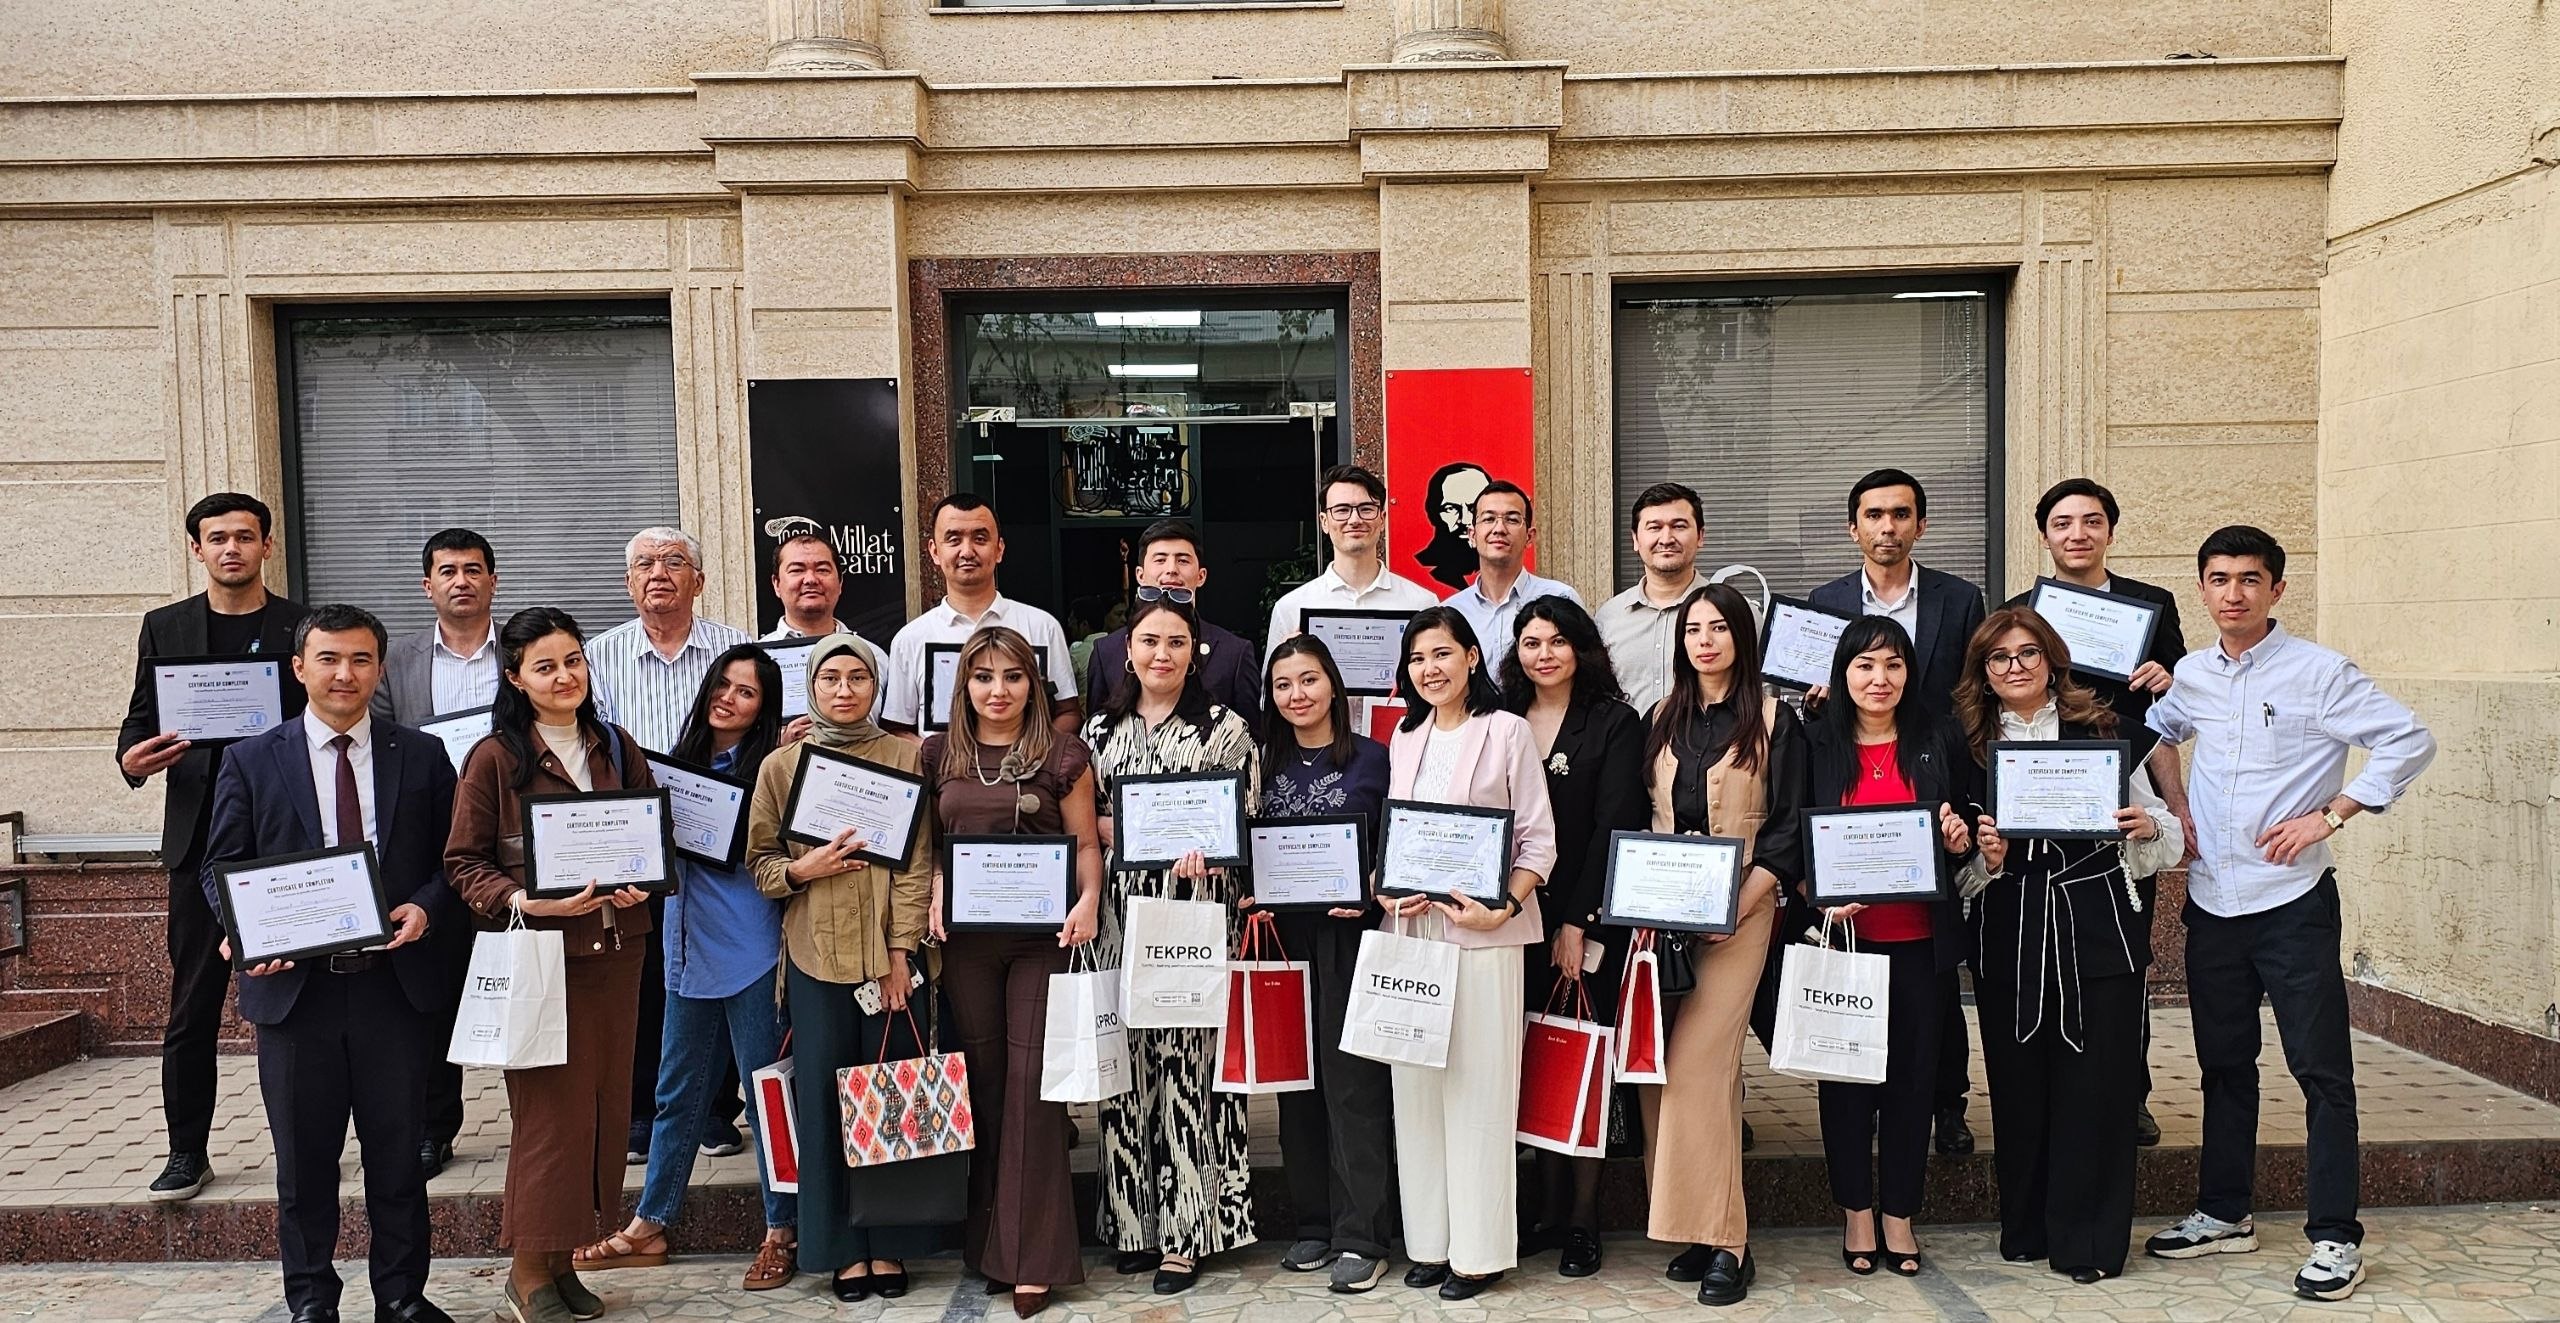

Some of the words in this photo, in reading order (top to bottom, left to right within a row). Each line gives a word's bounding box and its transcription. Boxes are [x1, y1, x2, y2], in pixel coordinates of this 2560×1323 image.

[830, 525, 894, 554] Millat
[840, 552, 894, 574] eatri
[566, 821, 594, 829] CERTIFICATE
[1145, 945, 1212, 960] TEKPRO
[476, 976, 510, 992] TEKPRO
[1371, 973, 1441, 998] TEKPRO
[1803, 987, 1873, 1010] TEKPRO
[1096, 1012, 1118, 1029] KPRO
